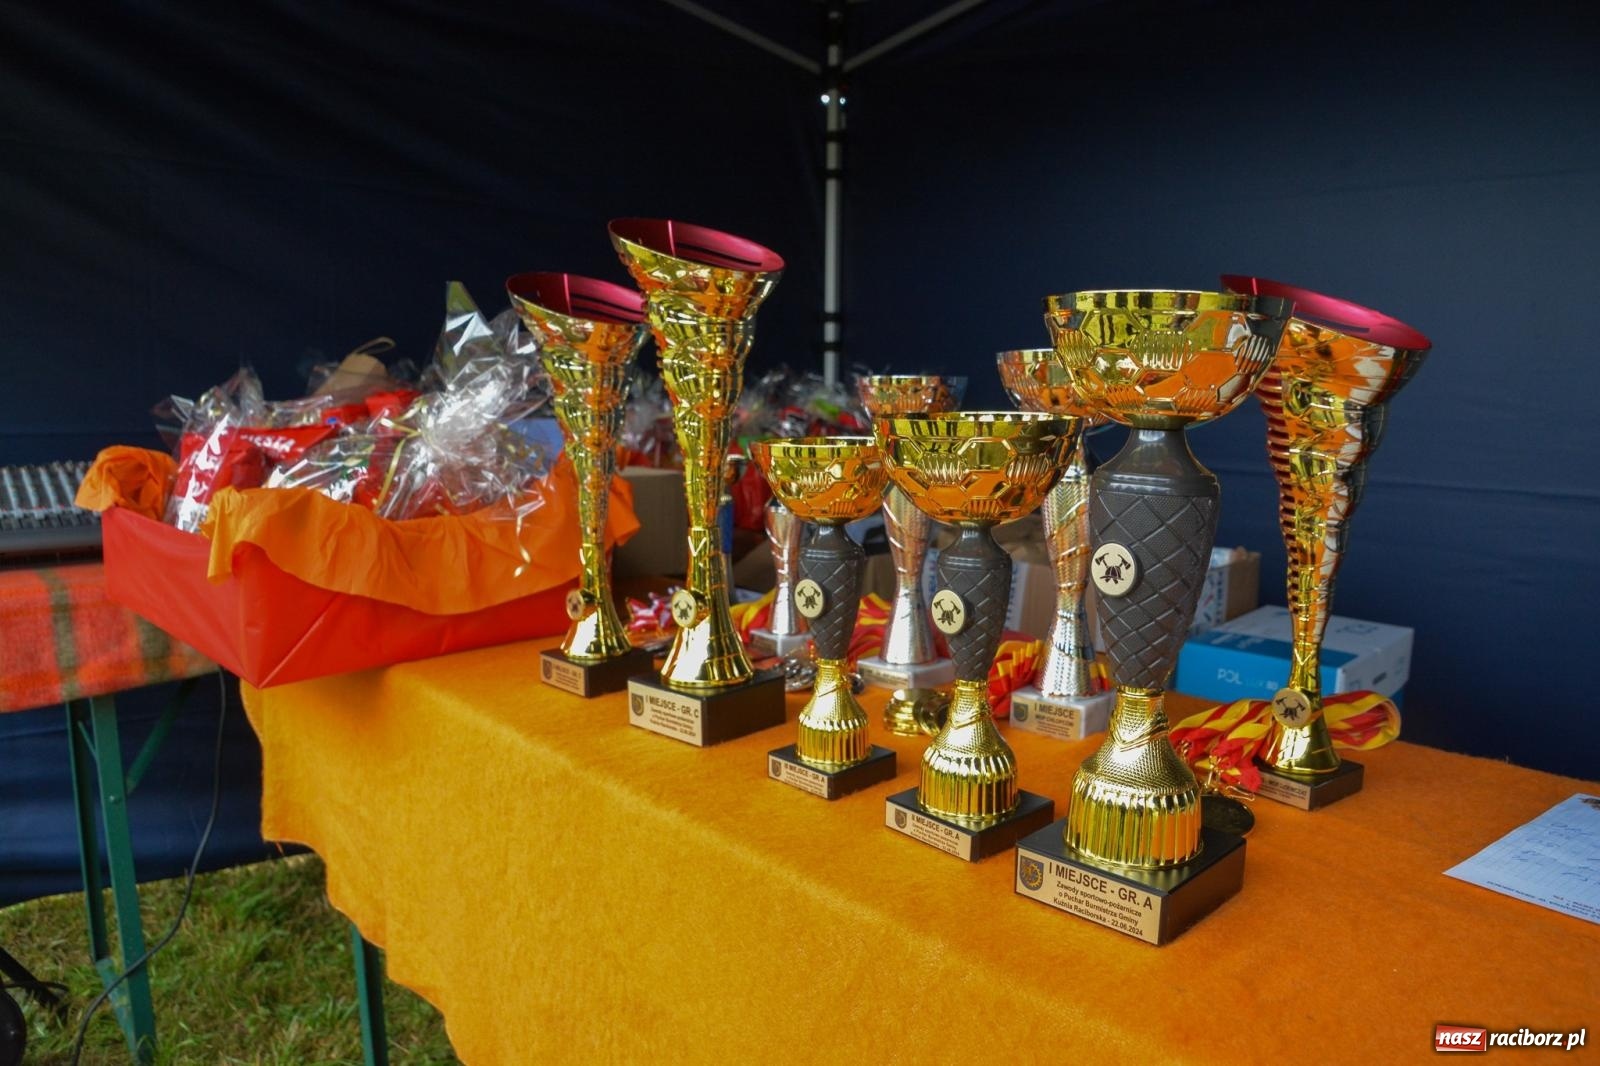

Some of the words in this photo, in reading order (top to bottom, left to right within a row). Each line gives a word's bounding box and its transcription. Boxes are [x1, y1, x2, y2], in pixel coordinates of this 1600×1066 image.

[649, 696, 676, 712] MIEJSCE
[681, 705, 692, 717] GR.
[693, 708, 700, 719] C
[1039, 703, 1075, 719] MIEJSCE
[916, 815, 940, 832] MIEJSCE
[955, 832, 960, 841] A
[1055, 864, 1108, 894] MIEJSCE
[1118, 887, 1140, 906] GR.
[1143, 896, 1153, 911] A
[1056, 880, 1079, 898] Zawody
[1063, 891, 1085, 905] Puchar
[1085, 899, 1118, 918] Burmistrza
[1073, 902, 1107, 923] Raciborska
[1111, 918, 1143, 937] 22.06.2024
